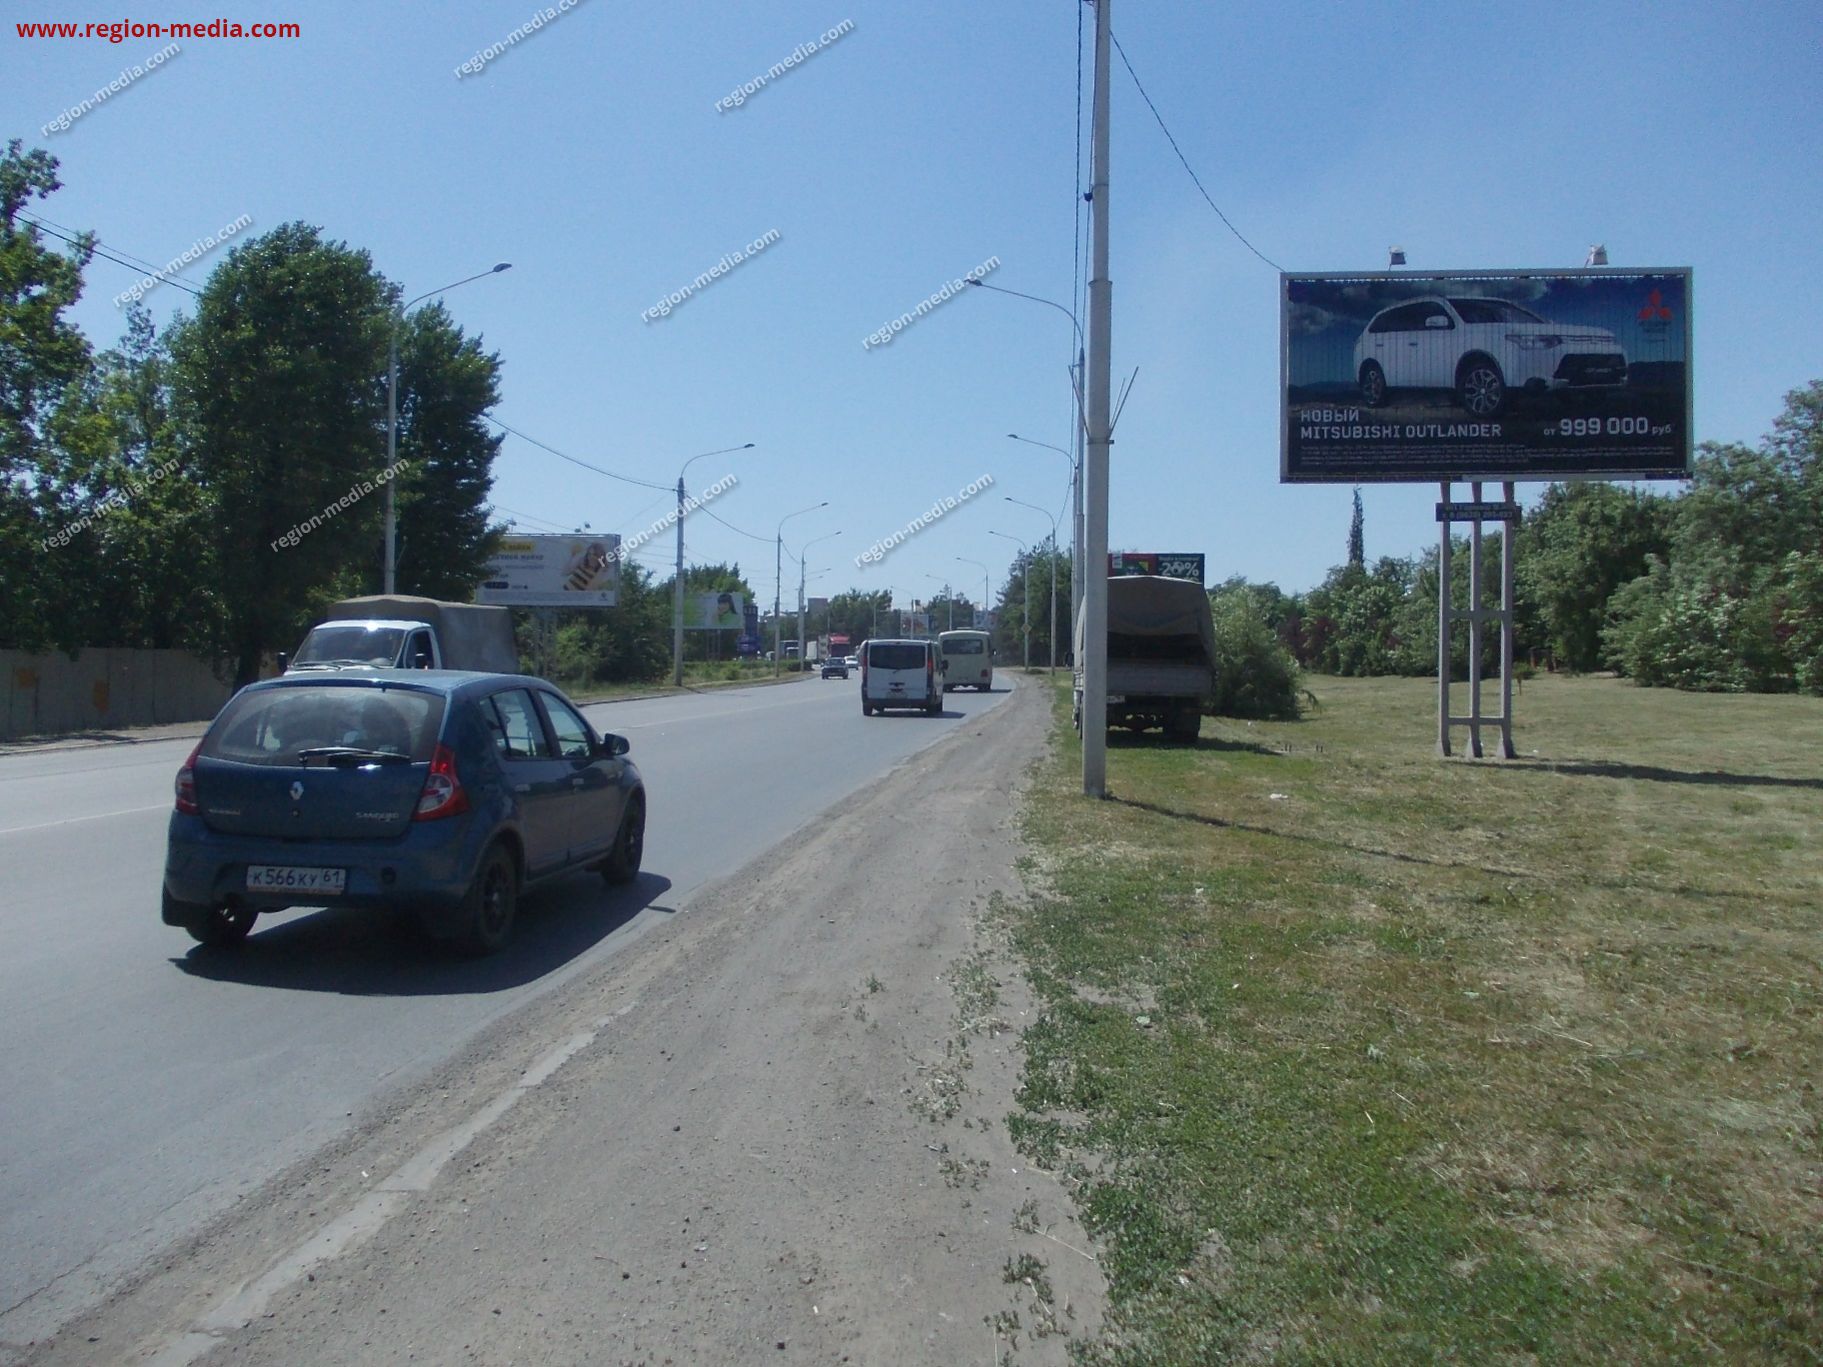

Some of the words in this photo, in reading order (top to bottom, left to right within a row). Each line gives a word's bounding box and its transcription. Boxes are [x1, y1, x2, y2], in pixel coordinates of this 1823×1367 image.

[1300, 407, 1360, 422] НОВЫЙ
[1300, 425, 1400, 439] MITSUBISHI
[1405, 424, 1501, 438] OUTLANDER
[1560, 418, 1601, 436] 999
[1607, 417, 1649, 434] 000
[1652, 424, 1672, 435] руб
